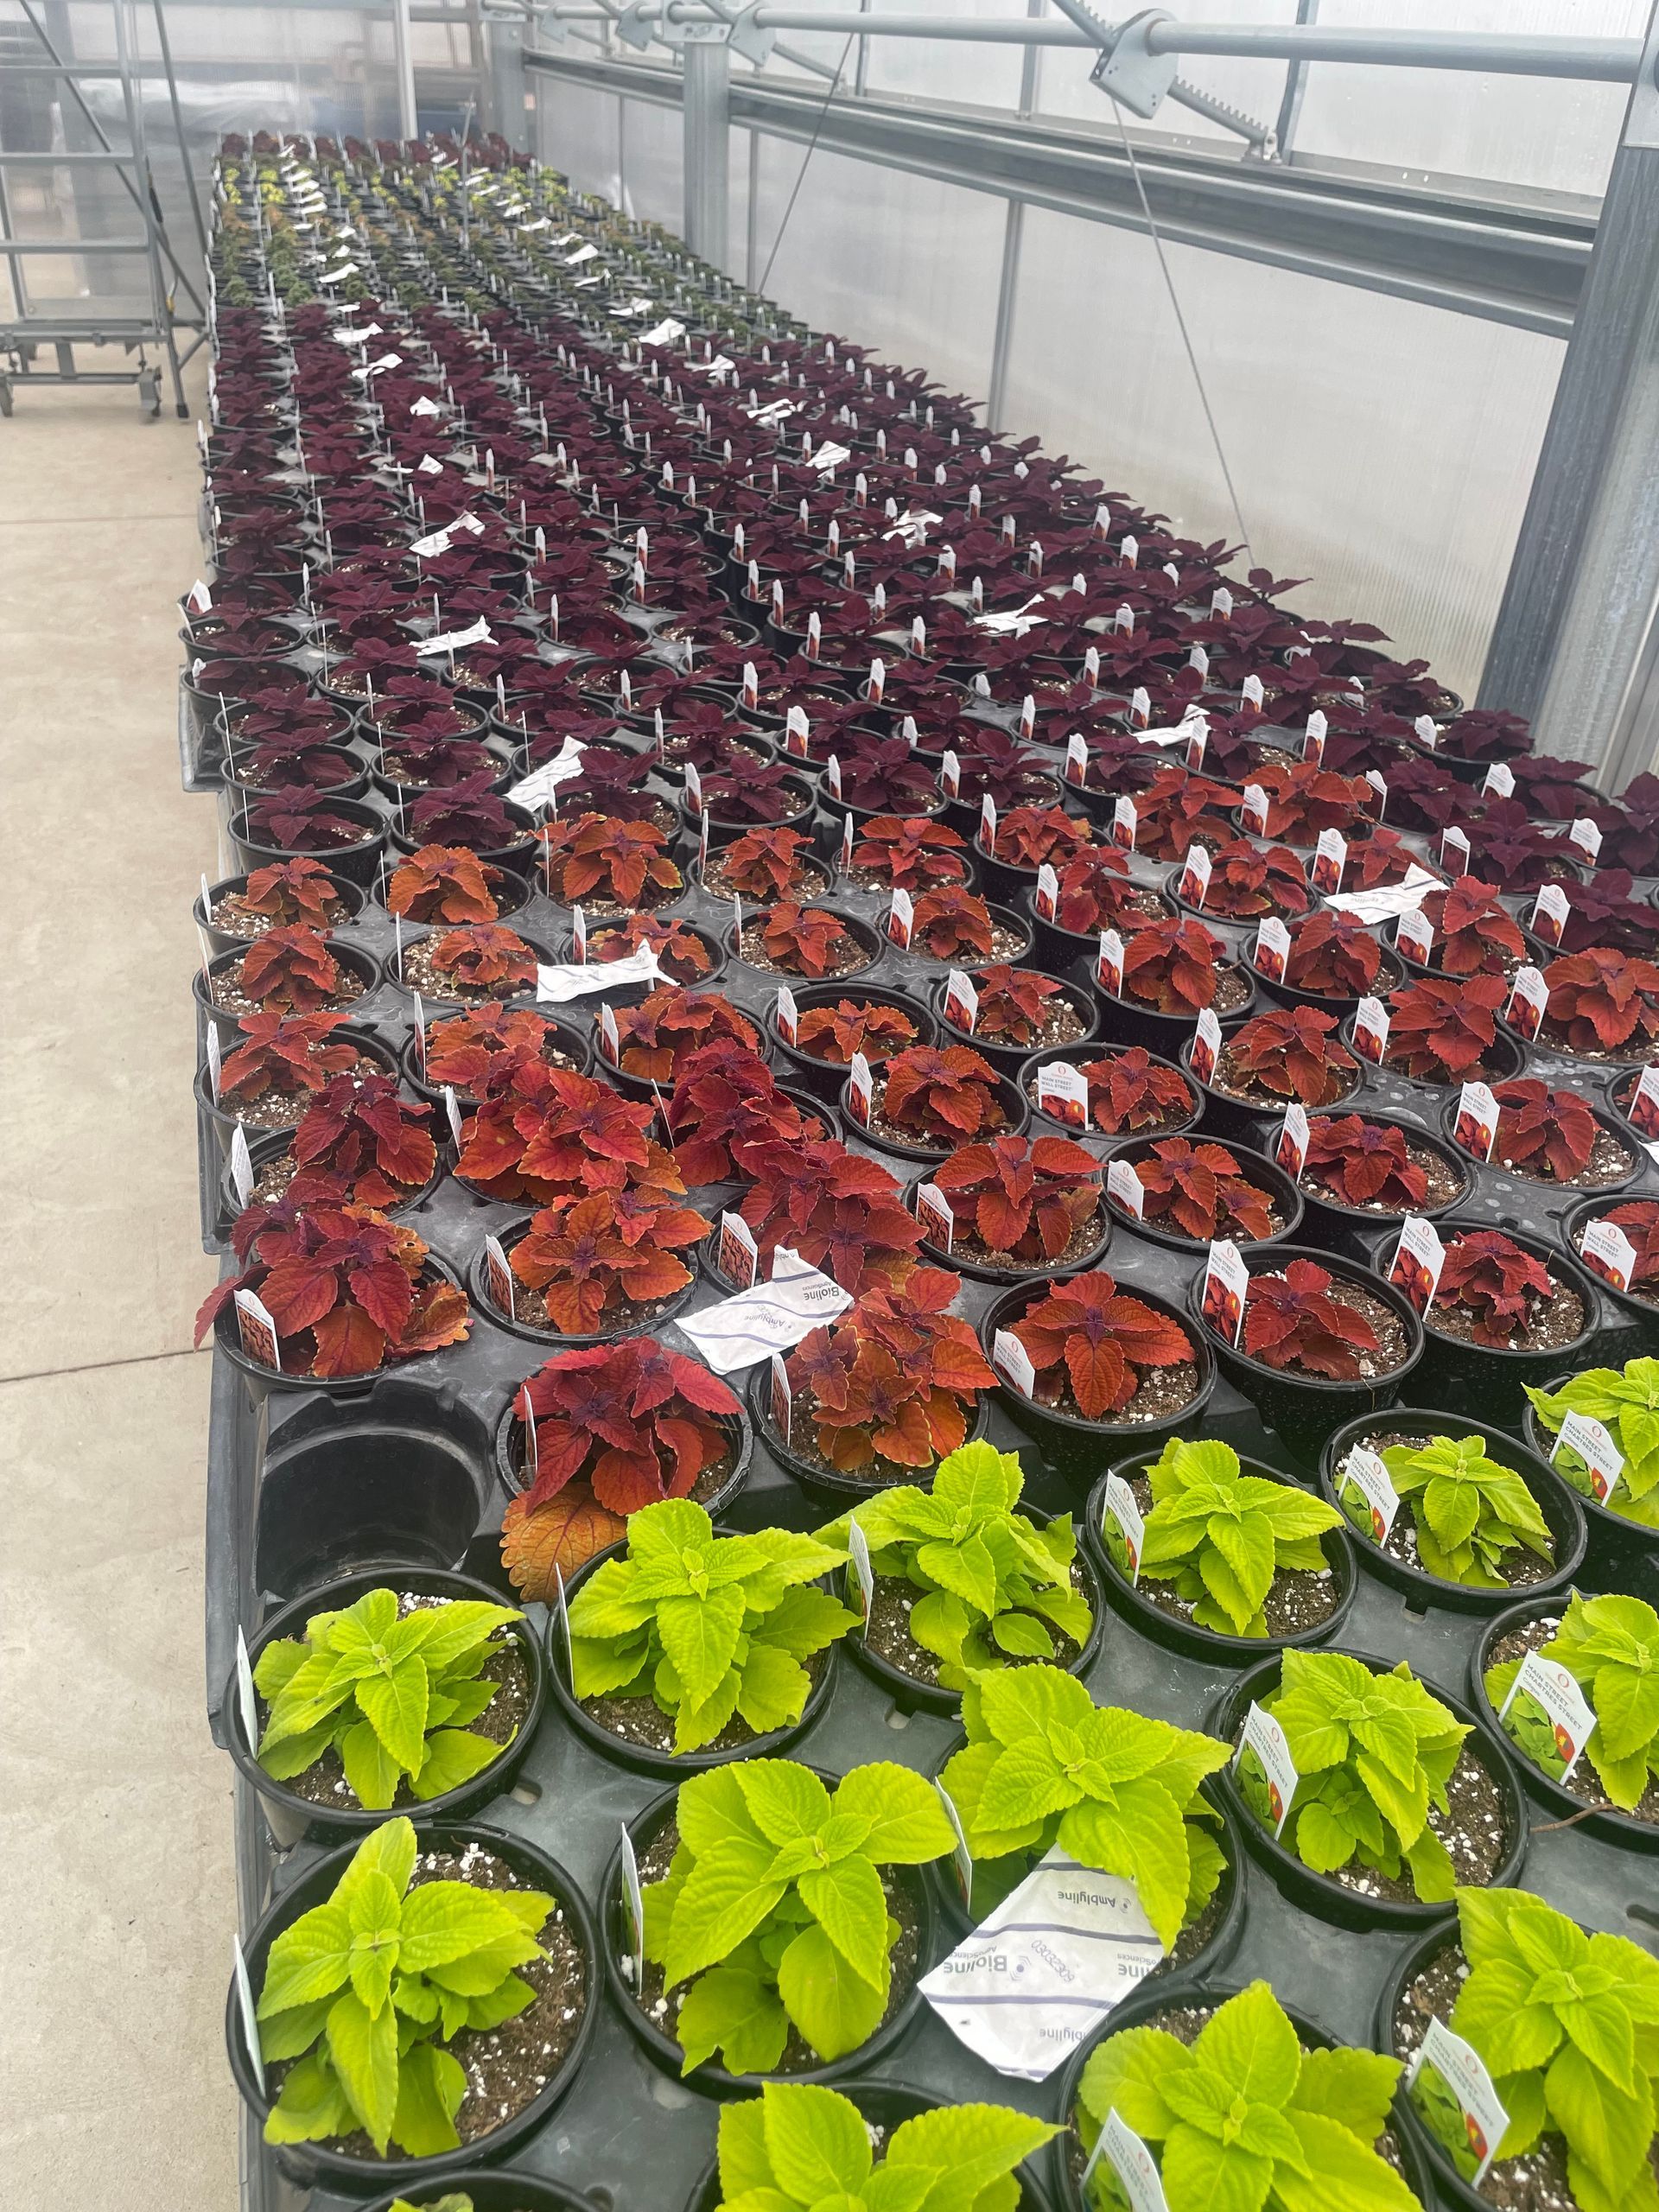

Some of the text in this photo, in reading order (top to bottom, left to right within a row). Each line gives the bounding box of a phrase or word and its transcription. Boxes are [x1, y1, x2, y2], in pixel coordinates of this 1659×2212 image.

[1416, 1236, 1431, 1252] STREET
[1601, 1239, 1619, 1253] STREET
[804, 1287, 840, 1300] Bioline
[1565, 1426, 1592, 1452] CHARTRES
[1592, 1452, 1614, 1471] STREET
[1567, 1421, 1581, 1435] MAIN
[1581, 1434, 1602, 1453] STREET
[1351, 1461, 1390, 1511] CHARTRES STREET
[1353, 1456, 1381, 1491] MAIN STREET
[1524, 1669, 1557, 1706] CHARTRES
[1558, 1704, 1583, 1730] STREET
[1527, 1663, 1544, 1682] MAIN
[1544, 1681, 1568, 1707] STREET
[1249, 1721, 1288, 1789] CHARTRES STREET
[1251, 1715, 1280, 1763] MAIN STREET
[1057, 1891, 1116, 1908] Amblyline
[944, 1955, 1007, 1974] Bioline
